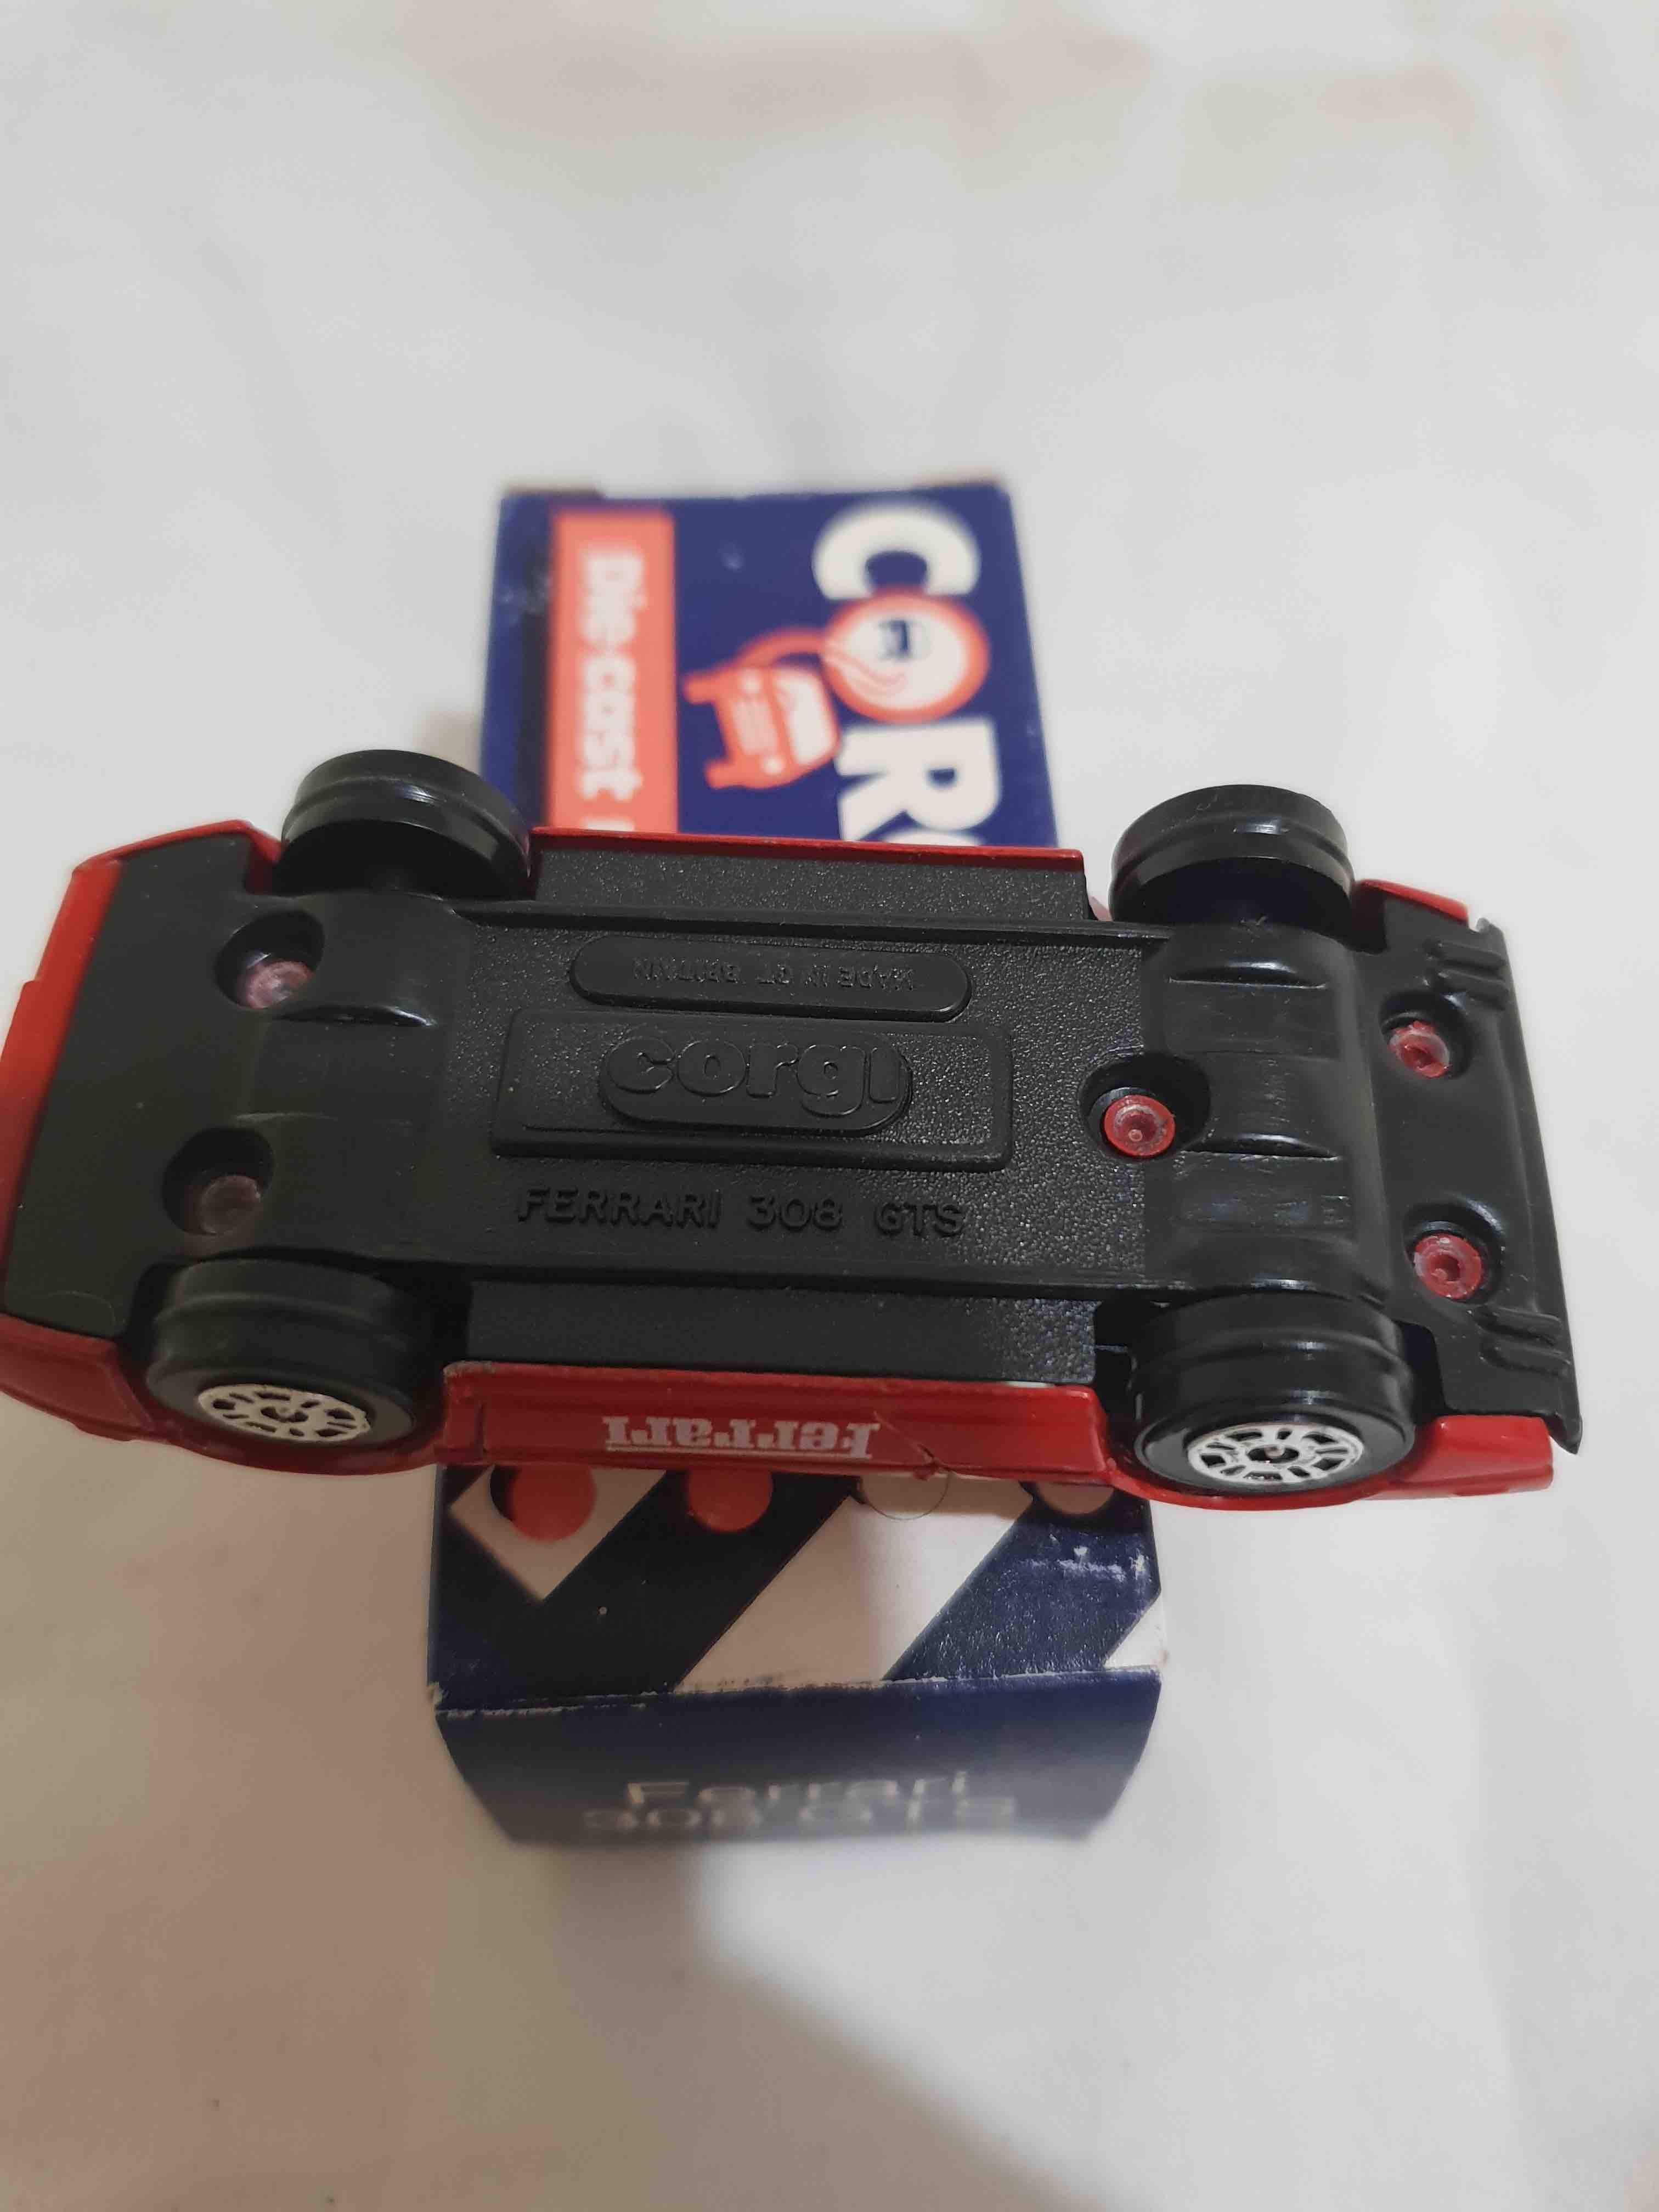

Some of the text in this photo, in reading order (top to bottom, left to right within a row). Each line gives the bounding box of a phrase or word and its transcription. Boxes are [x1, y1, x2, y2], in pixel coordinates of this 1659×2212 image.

[812, 504, 1002, 847] COR
[518, 1186, 967, 1237] FERRARI 308 GTS
